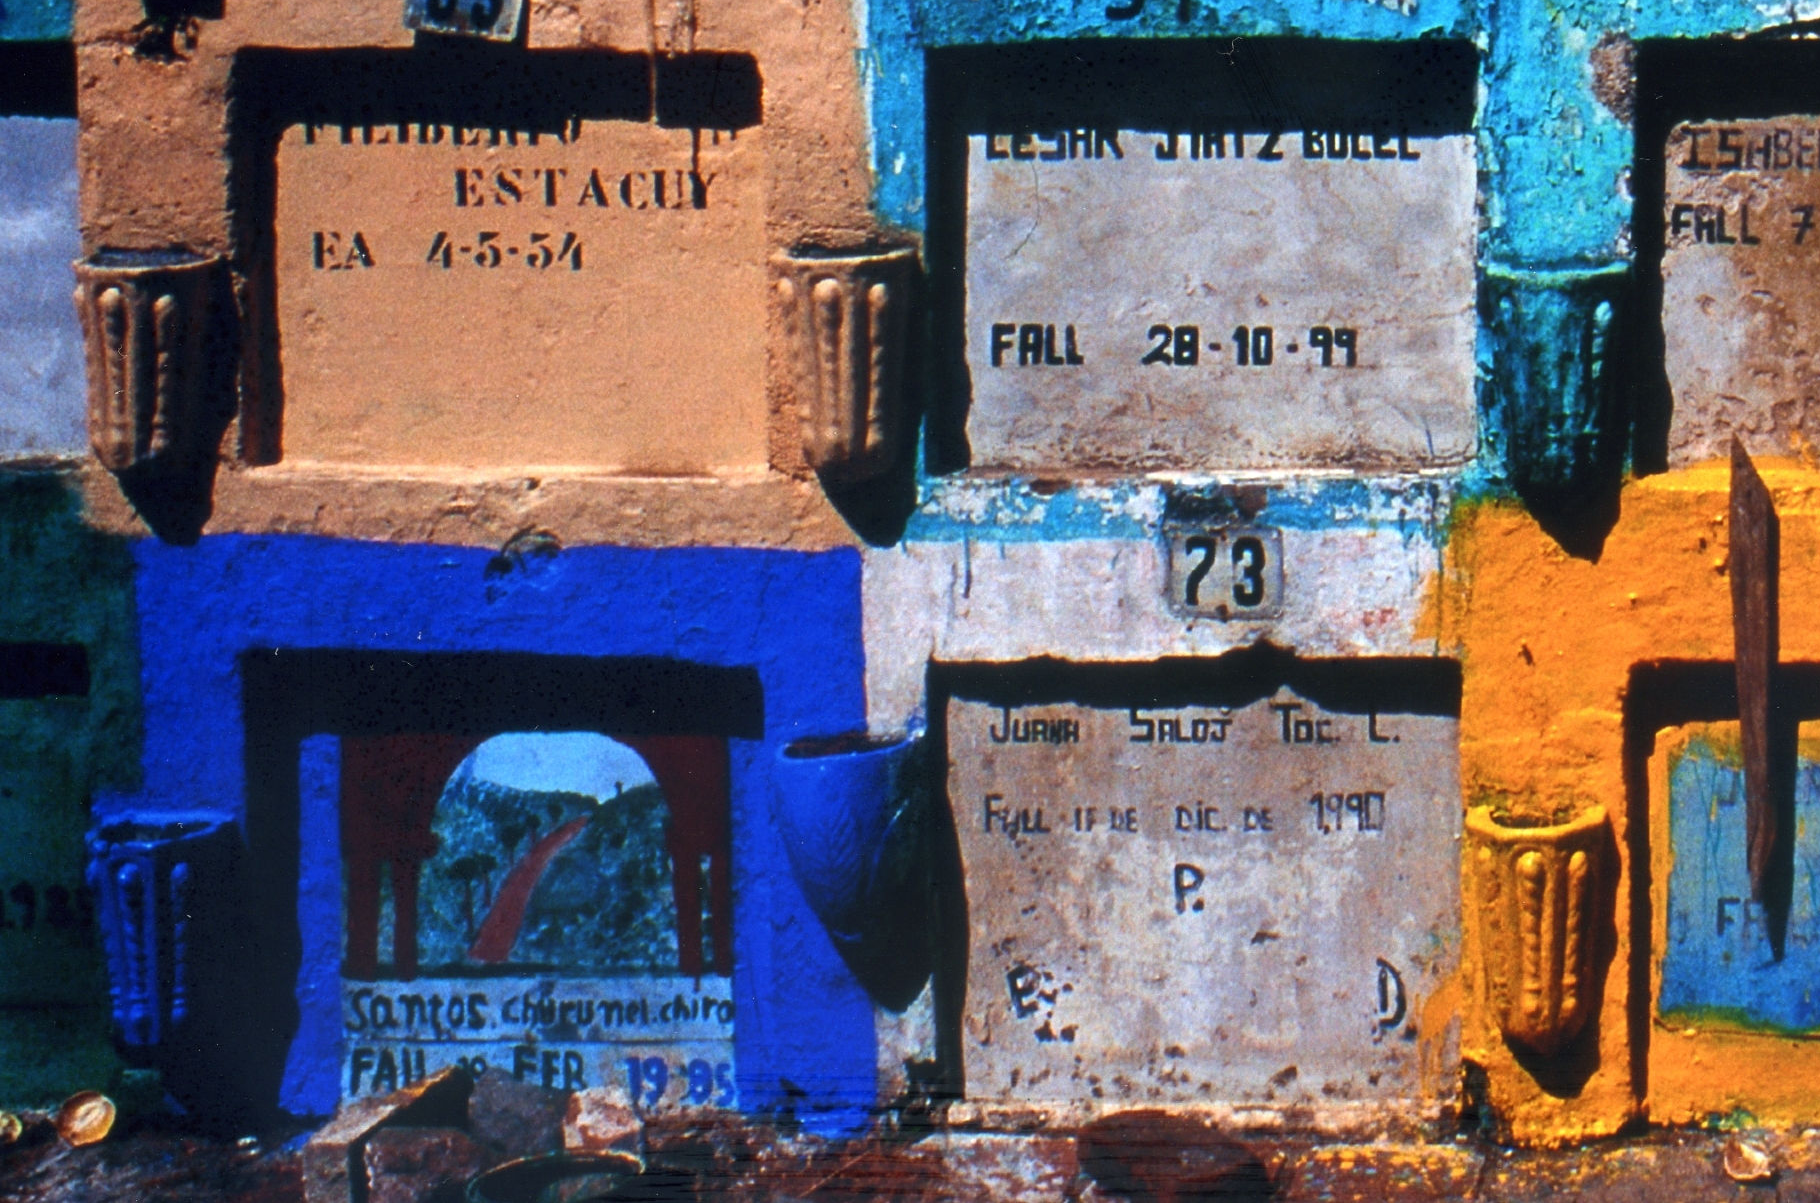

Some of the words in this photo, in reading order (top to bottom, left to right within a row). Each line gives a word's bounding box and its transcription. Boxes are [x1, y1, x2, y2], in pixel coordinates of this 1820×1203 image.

[1671, 203, 1762, 246] FALL
[990, 323, 1084, 368] FALL
[1184, 536, 1267, 608] 73
